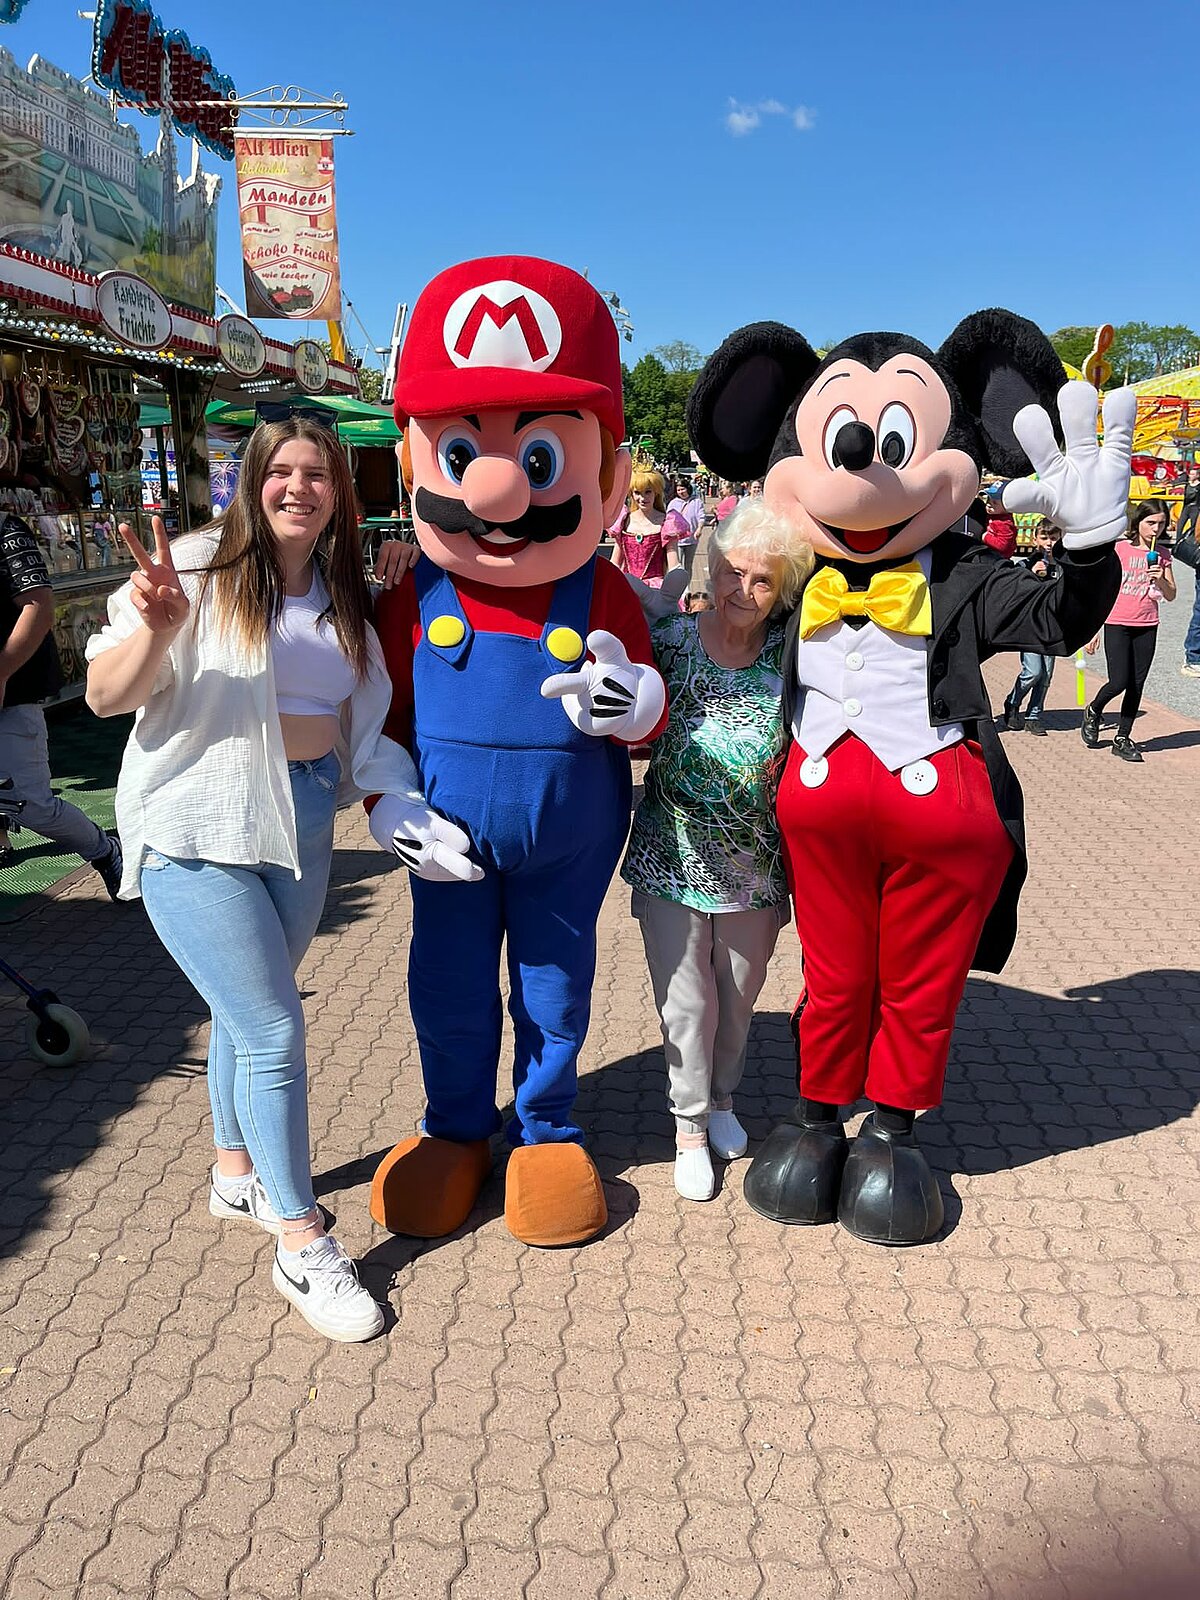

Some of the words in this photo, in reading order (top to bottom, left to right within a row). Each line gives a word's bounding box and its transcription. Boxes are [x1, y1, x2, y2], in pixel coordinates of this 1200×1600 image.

[238, 139, 264, 157] Alt
[266, 139, 309, 157] Wien
[248, 187, 327, 207] Mandeln
[244, 243, 288, 261] Schoko
[261, 271, 278, 279] wie
[113, 280, 156, 314] Kandierte
[118, 307, 156, 343] Früchte
[454, 293, 549, 363] M
